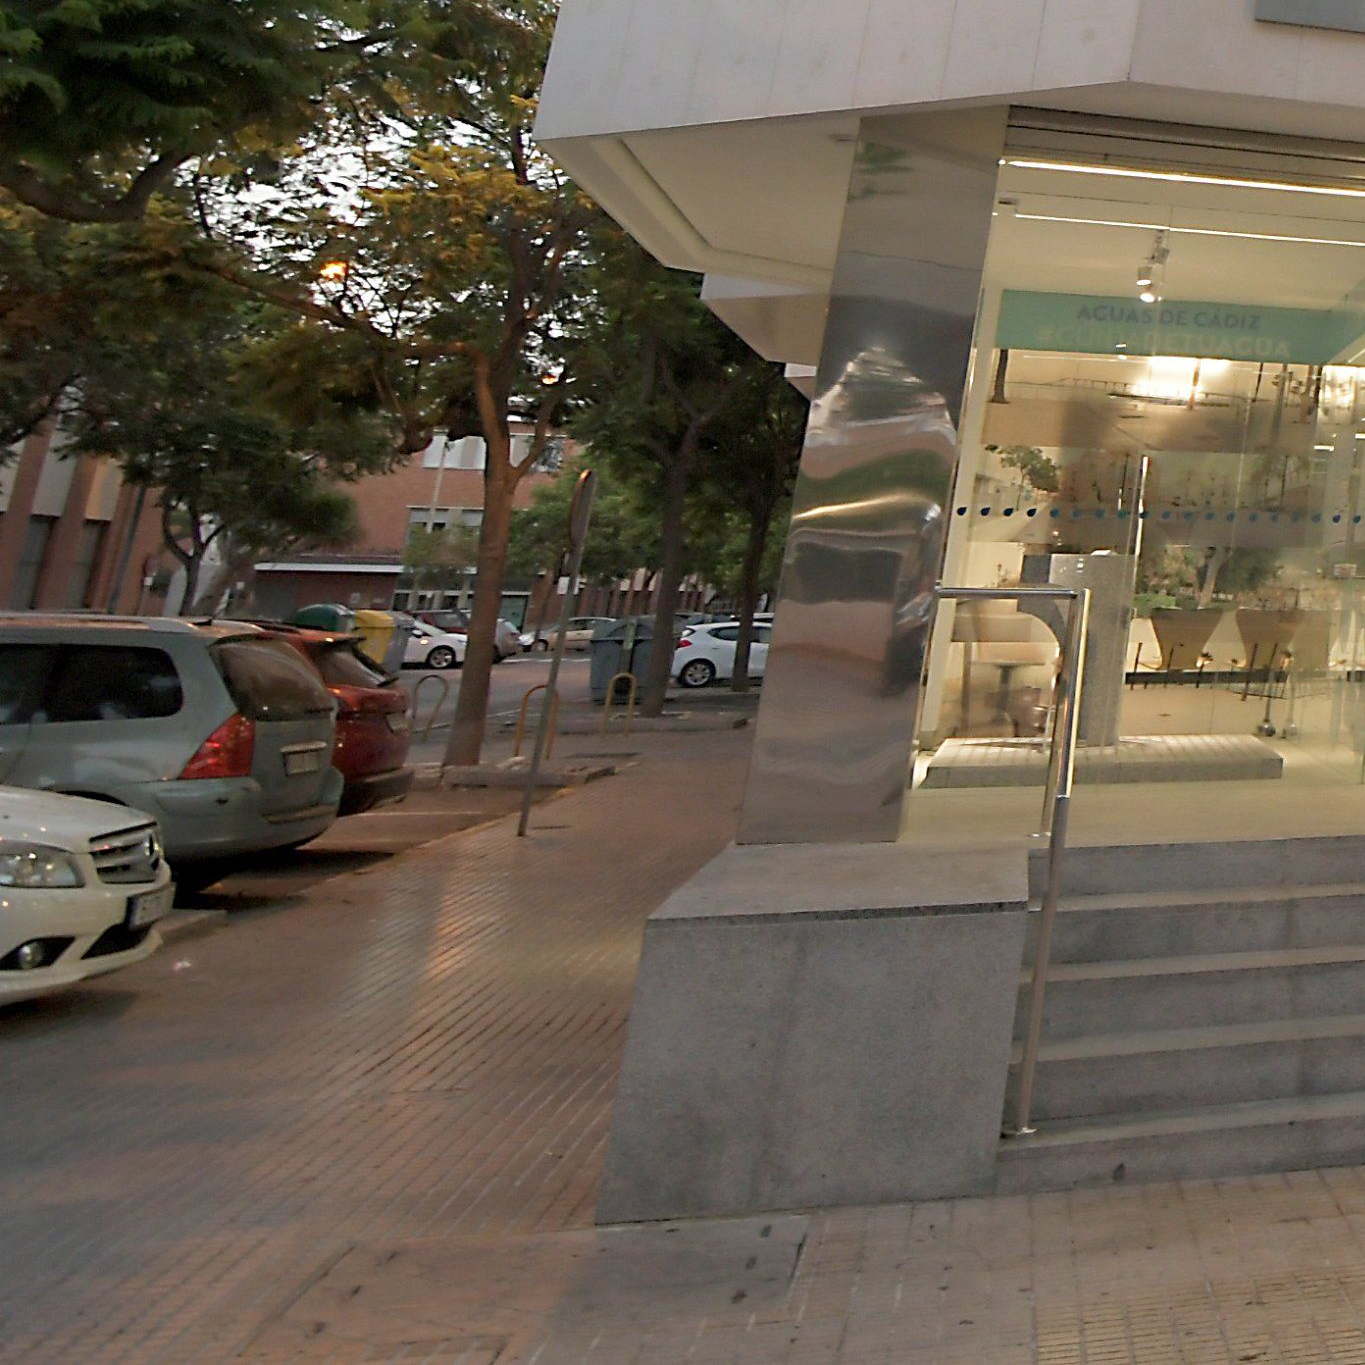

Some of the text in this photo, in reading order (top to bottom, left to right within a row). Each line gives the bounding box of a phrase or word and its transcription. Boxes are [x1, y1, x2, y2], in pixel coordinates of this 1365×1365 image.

[1076, 305, 1261, 331] AGUAS DE CÁDIZ
